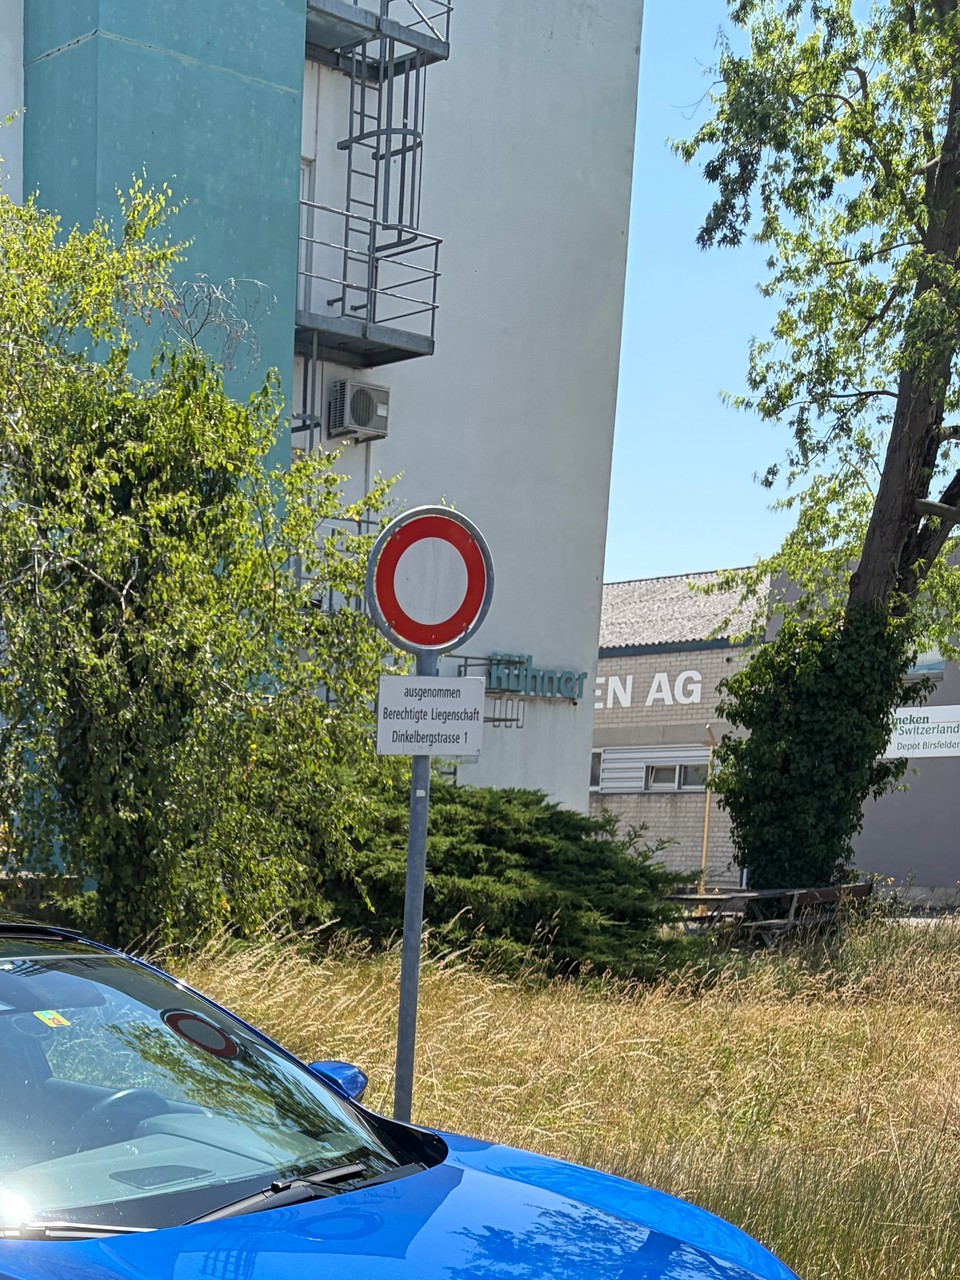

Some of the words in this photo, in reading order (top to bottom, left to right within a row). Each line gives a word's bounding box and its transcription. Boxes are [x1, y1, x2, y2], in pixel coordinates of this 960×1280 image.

[403, 687, 461, 701] ausgenommen
[644, 670, 702, 706] AG
[383, 706, 428, 723] Berechtigte
[431, 707, 480, 724] Liegenschaft
[894, 714, 929, 726] neken
[898, 723, 959, 736] Switzerland
[392, 730, 460, 747] Dinkelbergstrasse
[463, 731, 468, 744] 1
[896, 742, 920, 752] Depot
